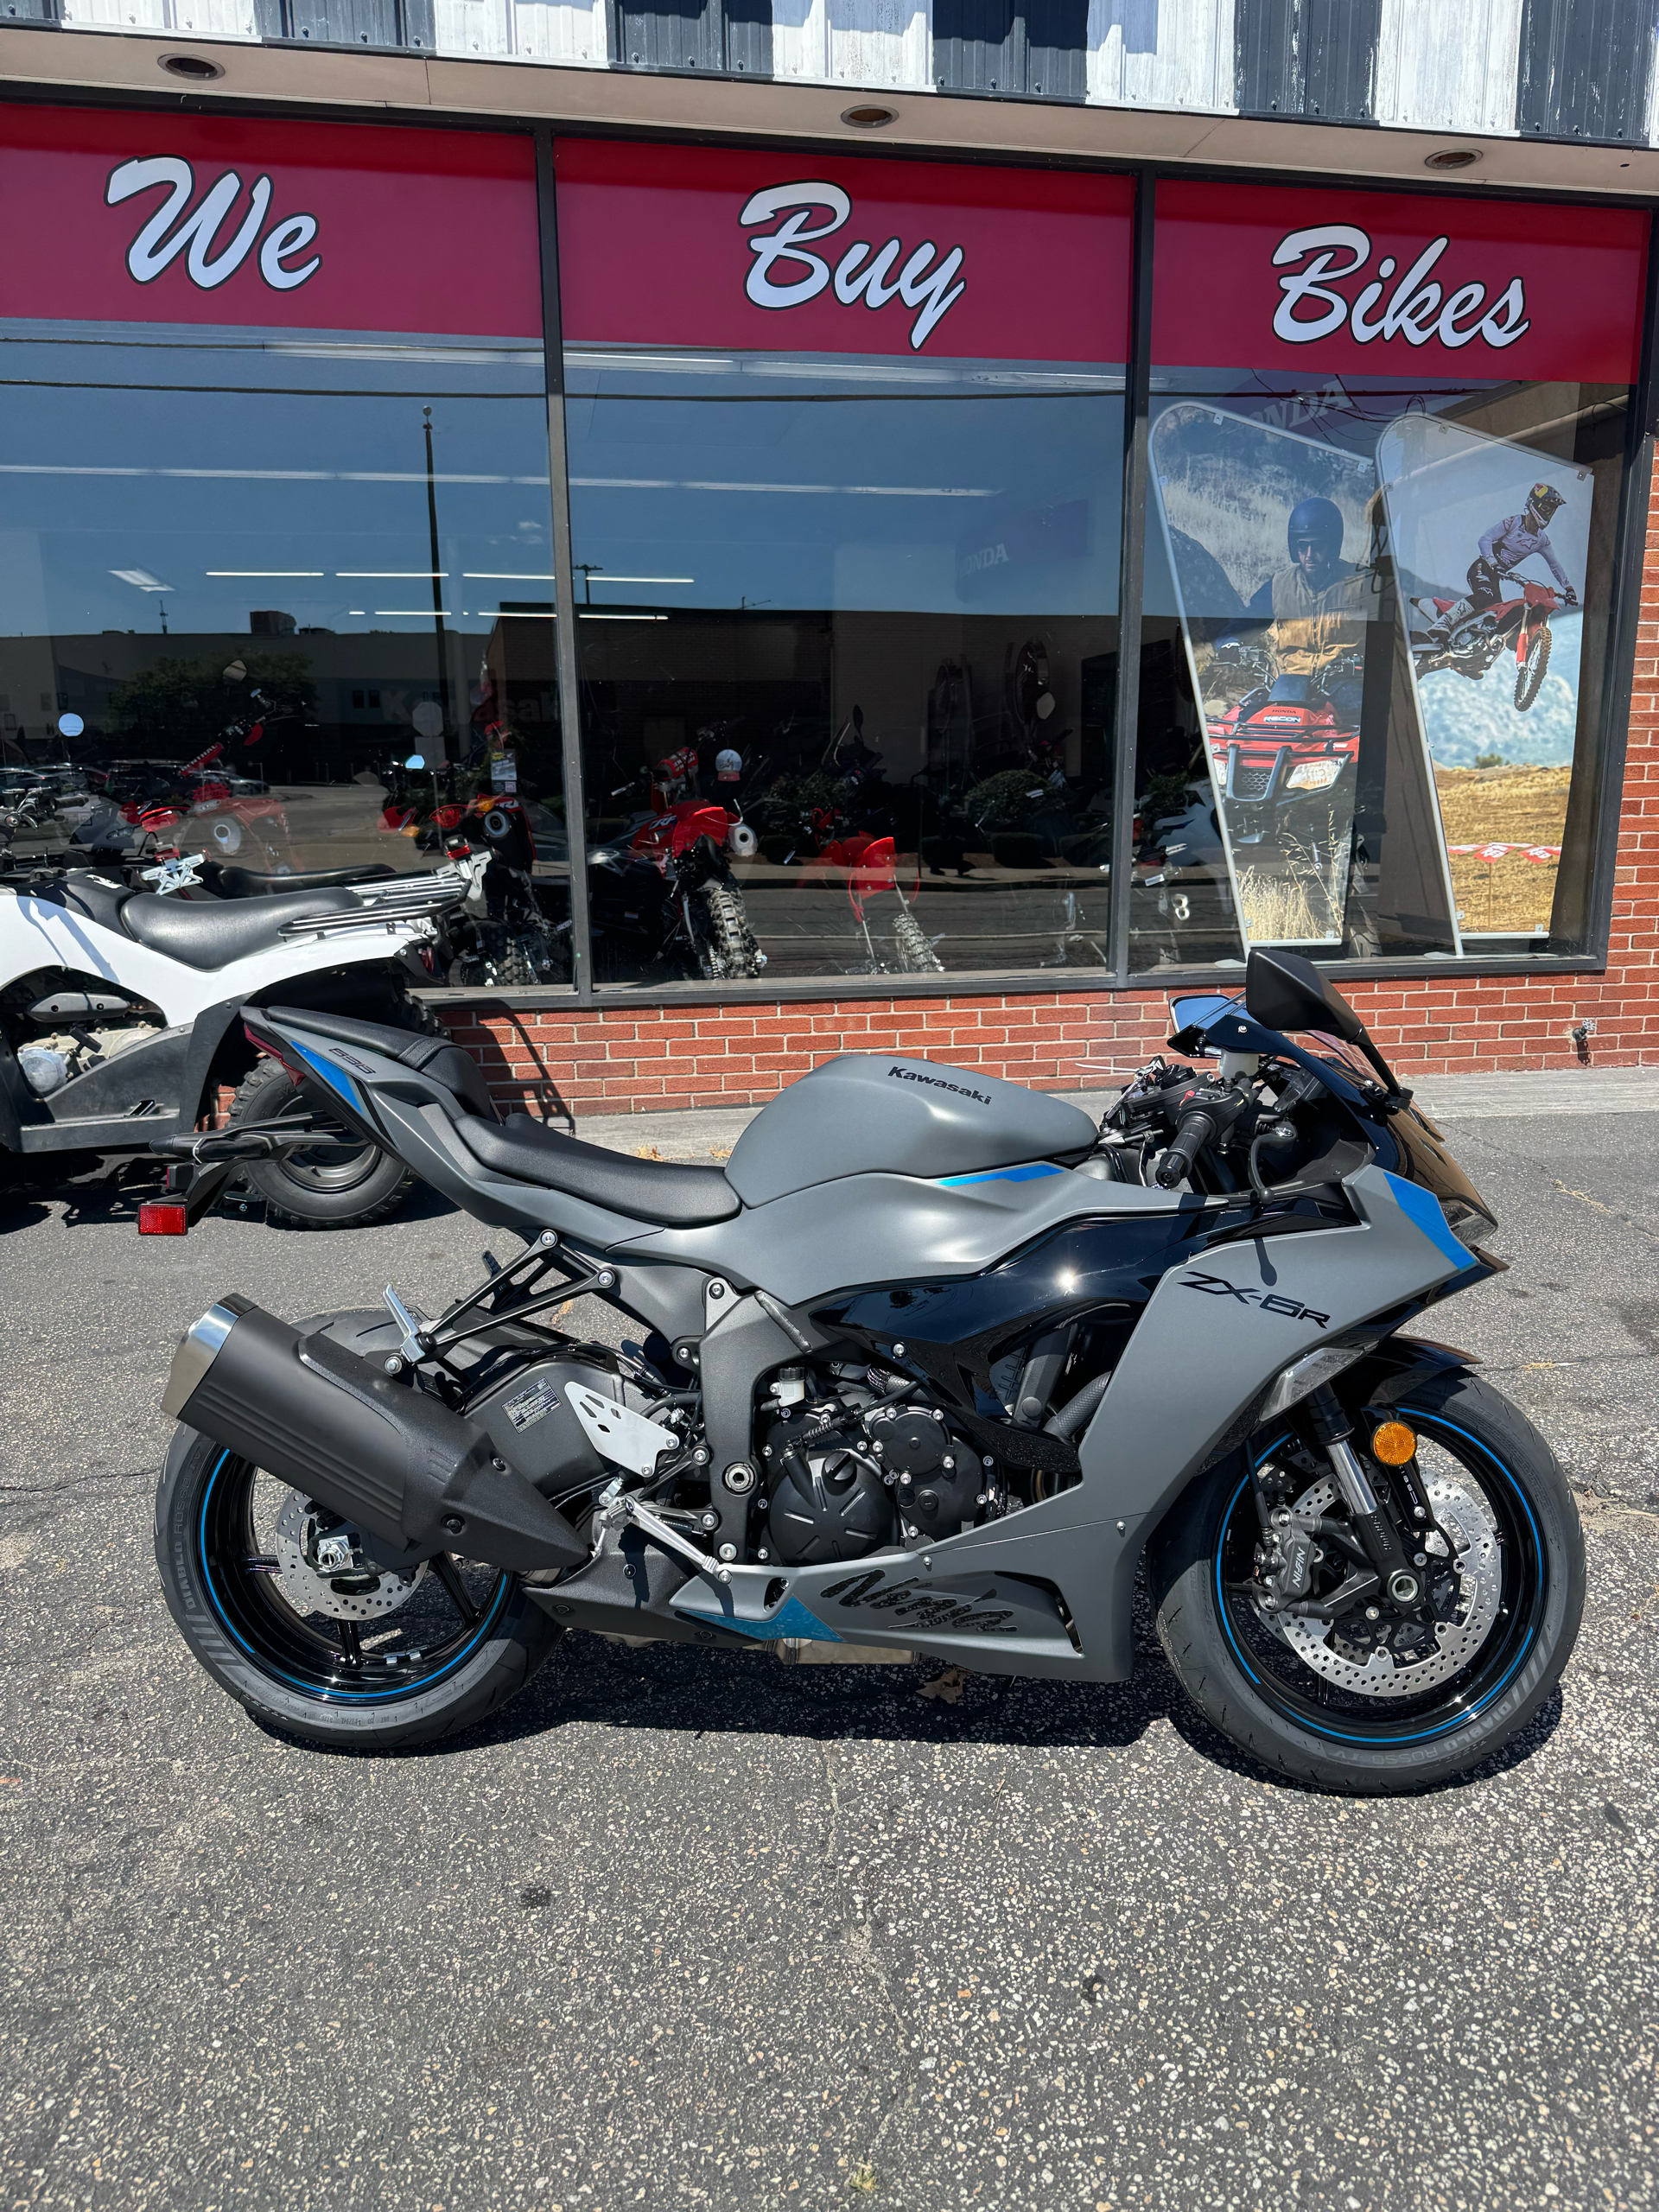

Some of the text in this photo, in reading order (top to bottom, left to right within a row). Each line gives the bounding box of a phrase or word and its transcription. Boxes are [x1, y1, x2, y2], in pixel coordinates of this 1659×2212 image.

[103, 153, 1530, 352] We Buy Bikes
[649, 816, 677, 830] CRF
[328, 1048, 376, 1074] 636
[887, 1066, 992, 1105] Kawasaki
[1175, 1271, 1331, 1329] ZX-6R
[174, 1478, 191, 1535] ROSSO
[175, 1541, 196, 1610] DIABLO
[1292, 1547, 1306, 1588] NISSIN
[820, 1569, 1018, 1632] Ninja
[1444, 1702, 1511, 1751] DIABLO
[1371, 1746, 1438, 1764] ROSSO
